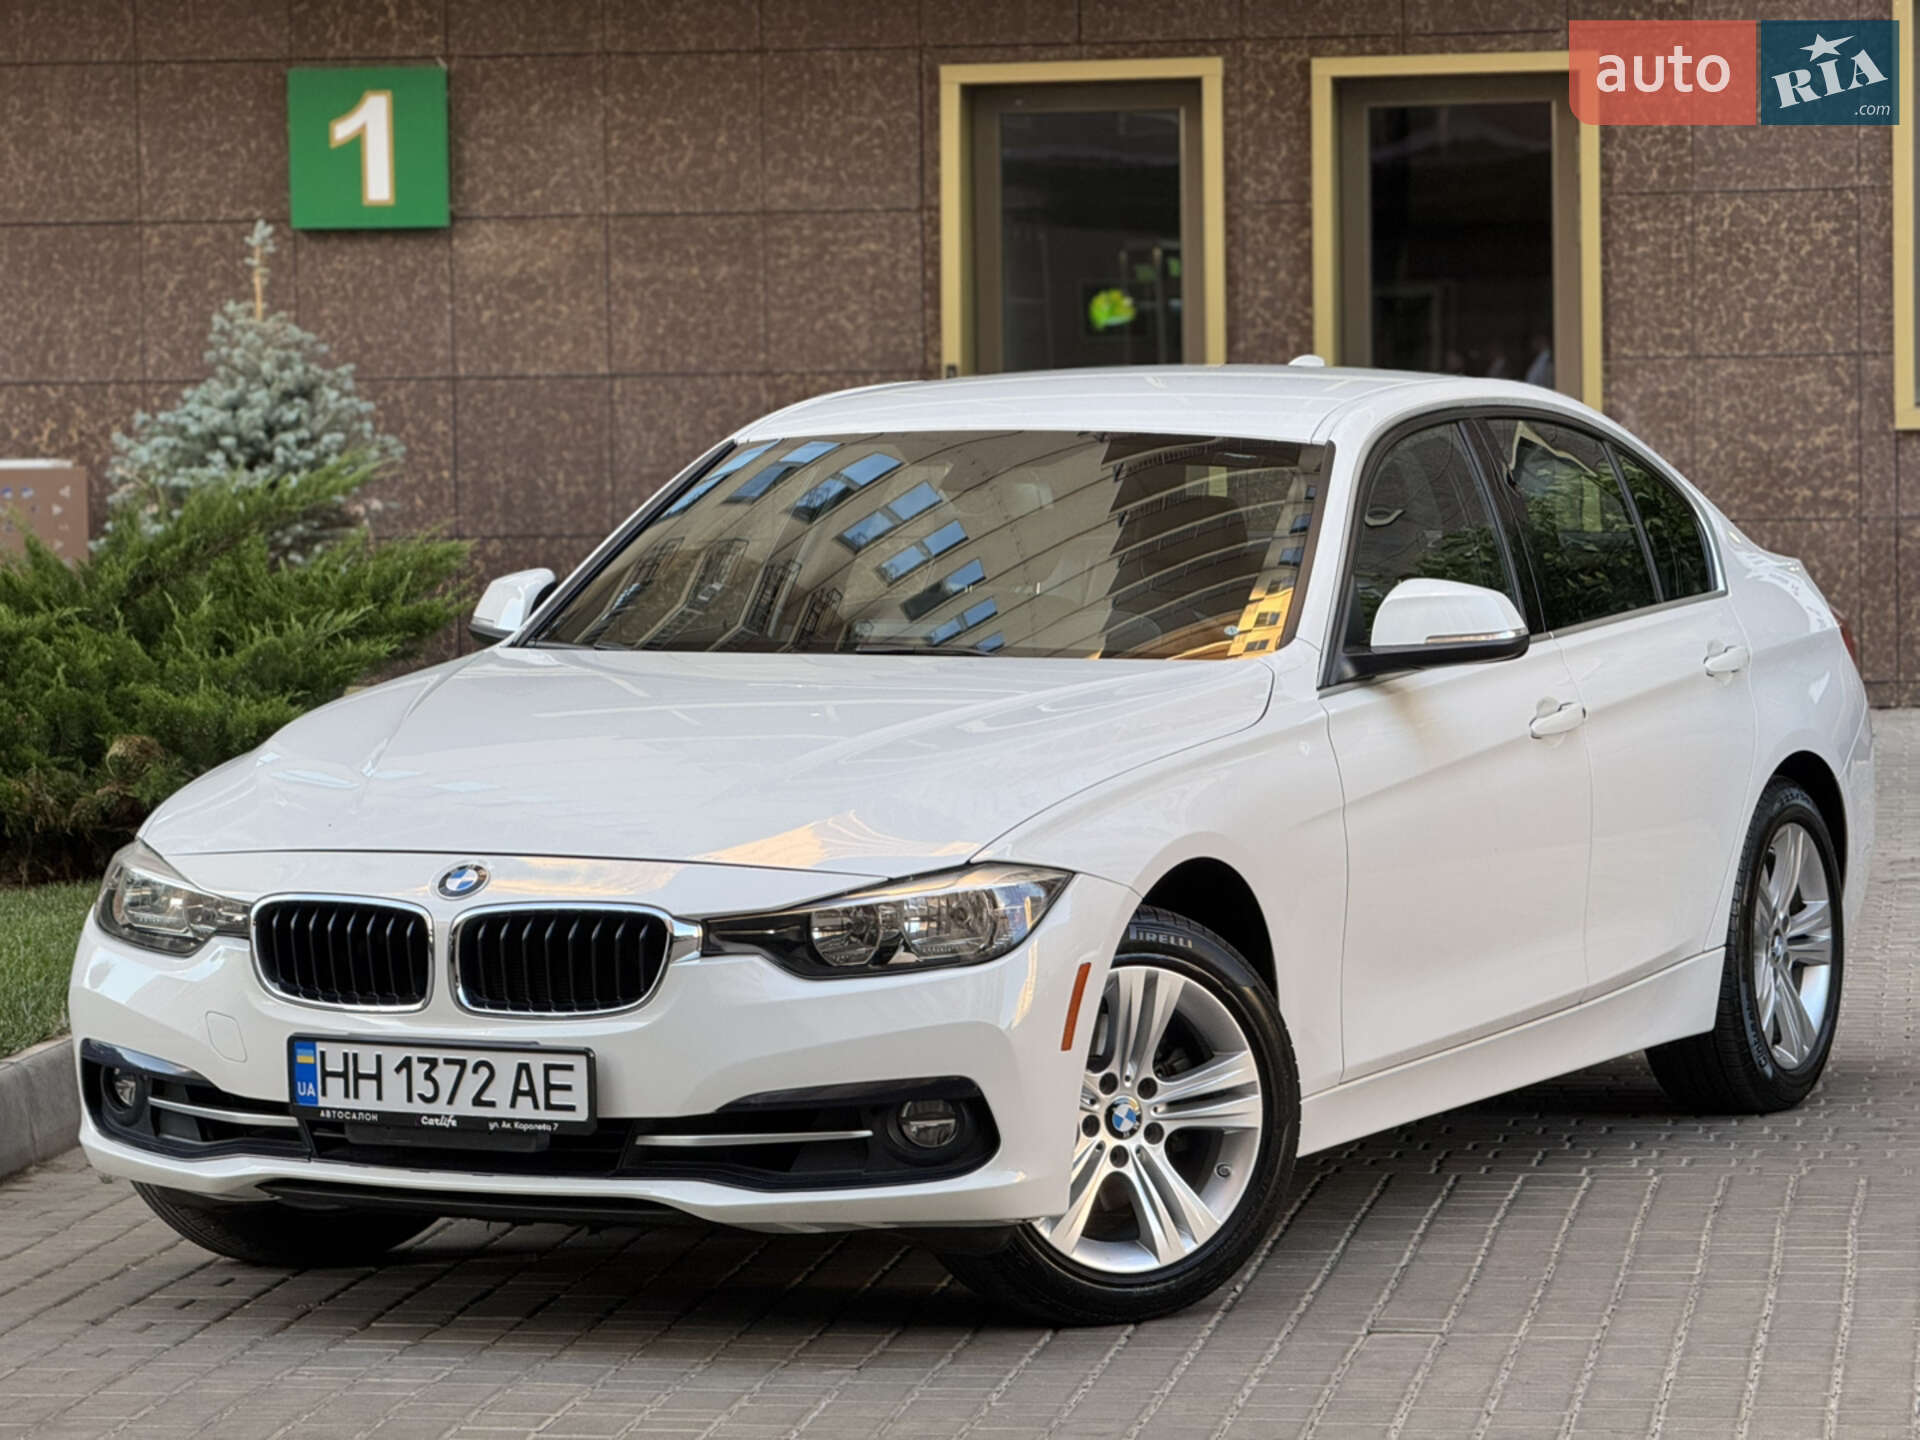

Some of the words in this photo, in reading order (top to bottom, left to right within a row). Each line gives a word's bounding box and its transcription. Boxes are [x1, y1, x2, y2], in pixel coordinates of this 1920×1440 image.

[329, 90, 395, 206] 1
[297, 1081, 316, 1097] UA
[394, 1055, 497, 1108] 1372
[509, 1061, 577, 1112] AE
[320, 1109, 378, 1121] АВТОСАЛОН
